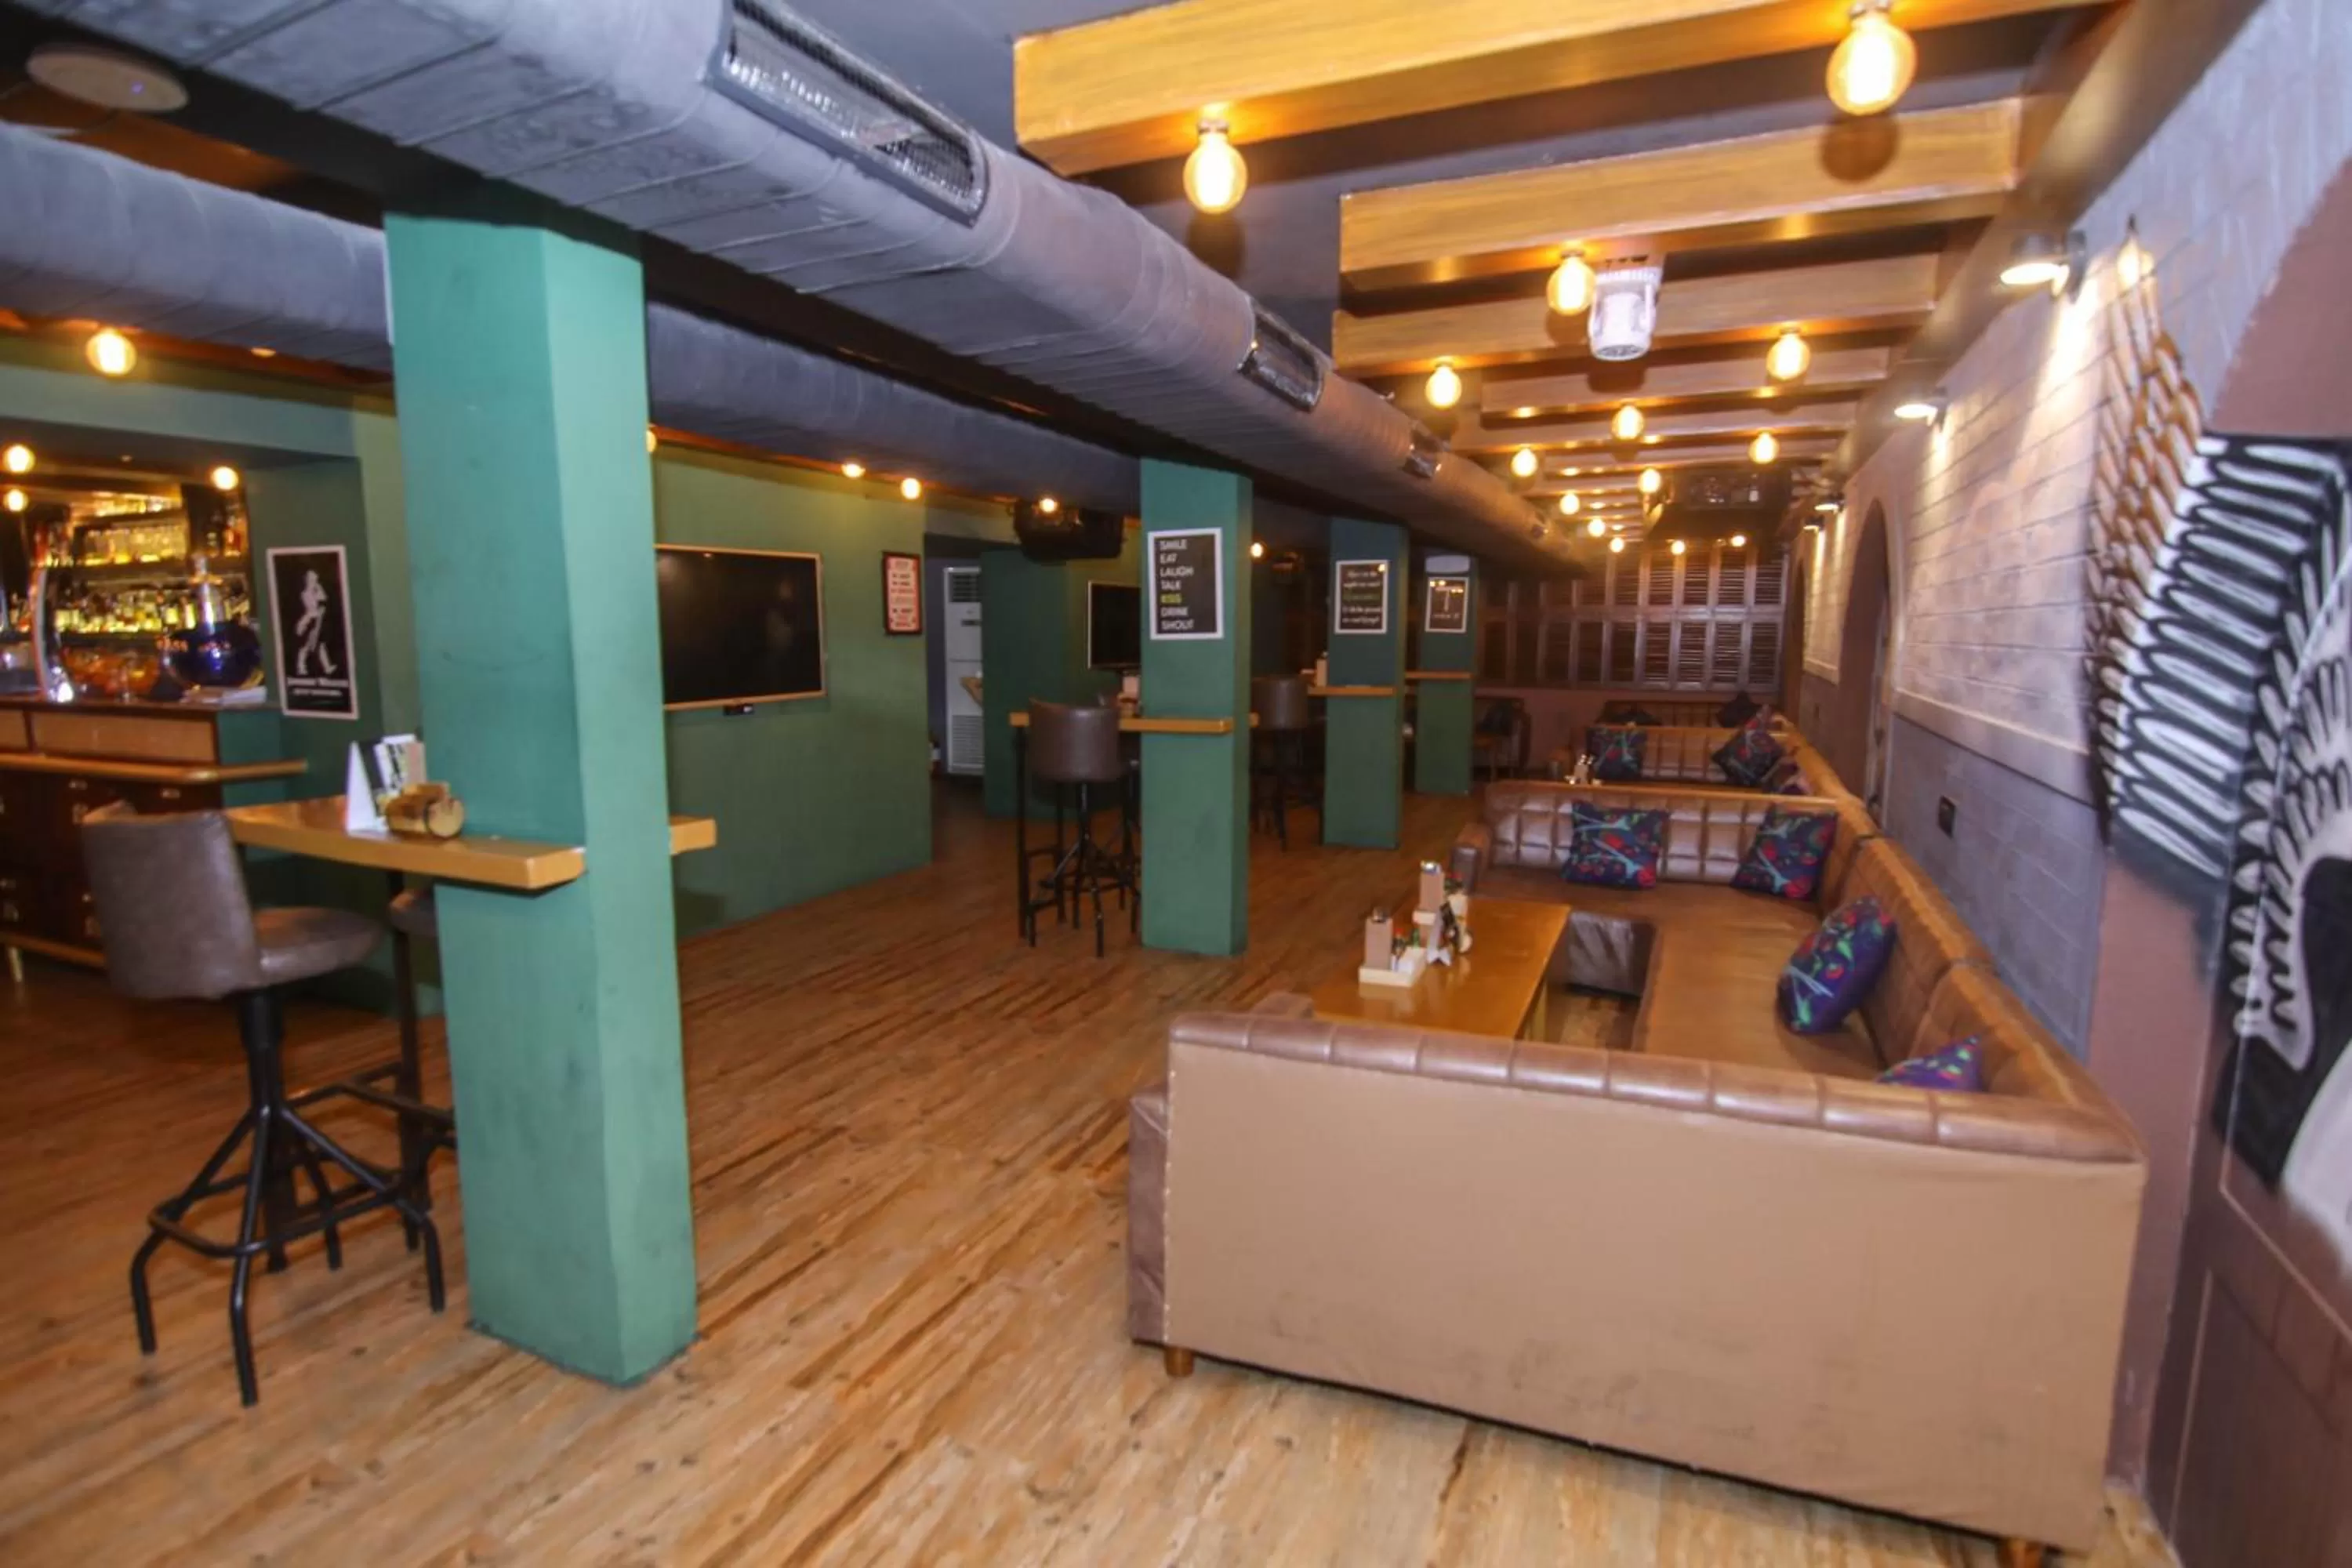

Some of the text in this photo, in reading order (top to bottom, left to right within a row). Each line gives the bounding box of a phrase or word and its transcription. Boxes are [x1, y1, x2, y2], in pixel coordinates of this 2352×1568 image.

[1160, 553, 1177, 564] EAT
[1160, 566, 1193, 577] LAUGH
[1161, 580, 1181, 590] TALK
